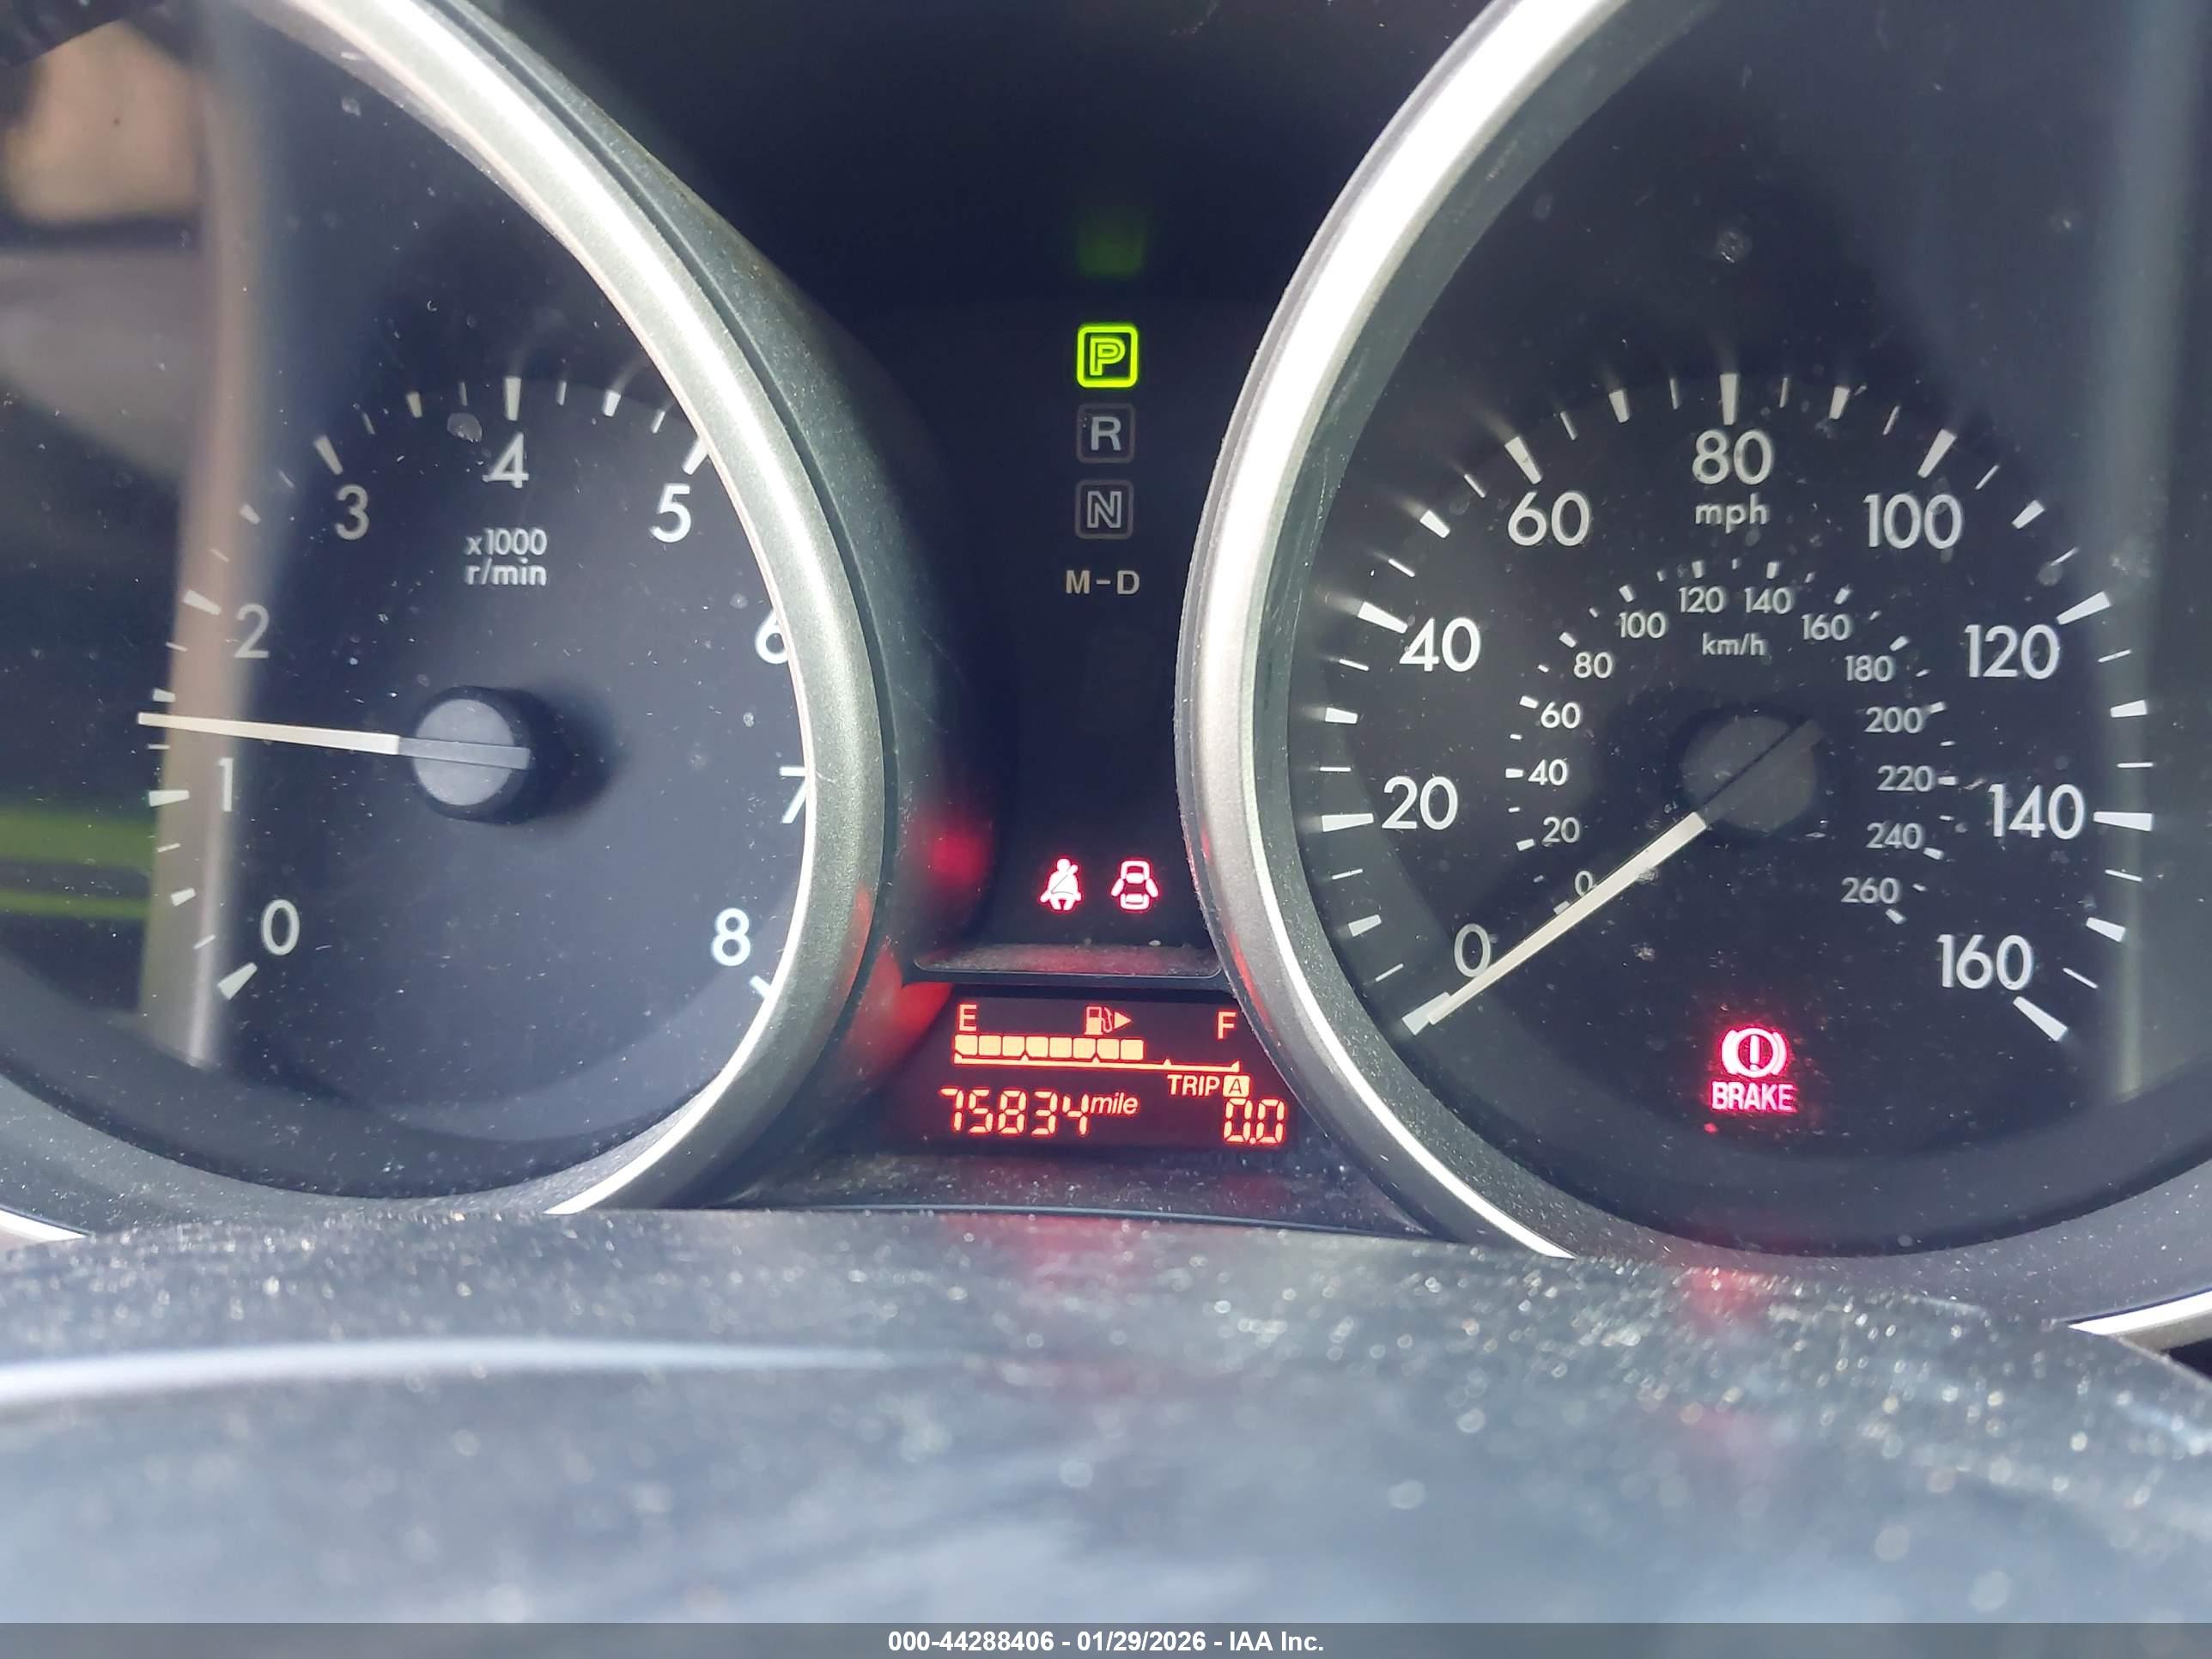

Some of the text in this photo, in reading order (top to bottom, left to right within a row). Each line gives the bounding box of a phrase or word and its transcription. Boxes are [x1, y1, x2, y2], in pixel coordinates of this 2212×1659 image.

[1089, 337, 1126, 376] P
[1091, 416, 1121, 451] R
[484, 433, 529, 488] 4
[1692, 429, 1774, 485] 80
[335, 485, 368, 540] 3
[651, 483, 692, 543] 5
[1086, 490, 1122, 529] N
[1507, 492, 1590, 548] 60
[1695, 498, 1768, 533] mph
[1864, 493, 1964, 550] 100
[465, 528, 548, 556] x1000
[465, 560, 547, 586] r/min
[1679, 586, 1725, 614] 120
[1744, 586, 1793, 616] 140
[234, 604, 269, 659] 2
[1619, 611, 1667, 640] 100
[1802, 613, 1851, 641] 160
[1399, 617, 1480, 673] 40
[1701, 632, 1766, 659] km/h
[1965, 623, 2060, 680] 120
[1573, 651, 1613, 679] 80
[1845, 653, 1894, 682] 180
[1540, 701, 1581, 730] 60
[1864, 706, 1922, 734] 200
[218, 757, 233, 811] 1
[1528, 757, 1569, 787] 40
[1877, 764, 1934, 793] 220
[1382, 775, 1458, 831] 20
[1989, 783, 2084, 840] 140
[1543, 816, 1581, 844] 20
[1866, 822, 1923, 851] 240
[1574, 870, 1594, 897] 0
[1840, 877, 1899, 906] 260
[261, 899, 301, 955] 0
[711, 908, 751, 966] 8
[1454, 922, 1493, 977] 0
[1937, 934, 2033, 991] 160
[958, 1004, 978, 1032] E
[1218, 1011, 1237, 1039] F
[1167, 1074, 1220, 1097] TRIP
[1711, 1081, 1796, 1112] BRAKE
[939, 1088, 1139, 1135] 75834 mile
[1224, 1098, 1285, 1145] 0.0
